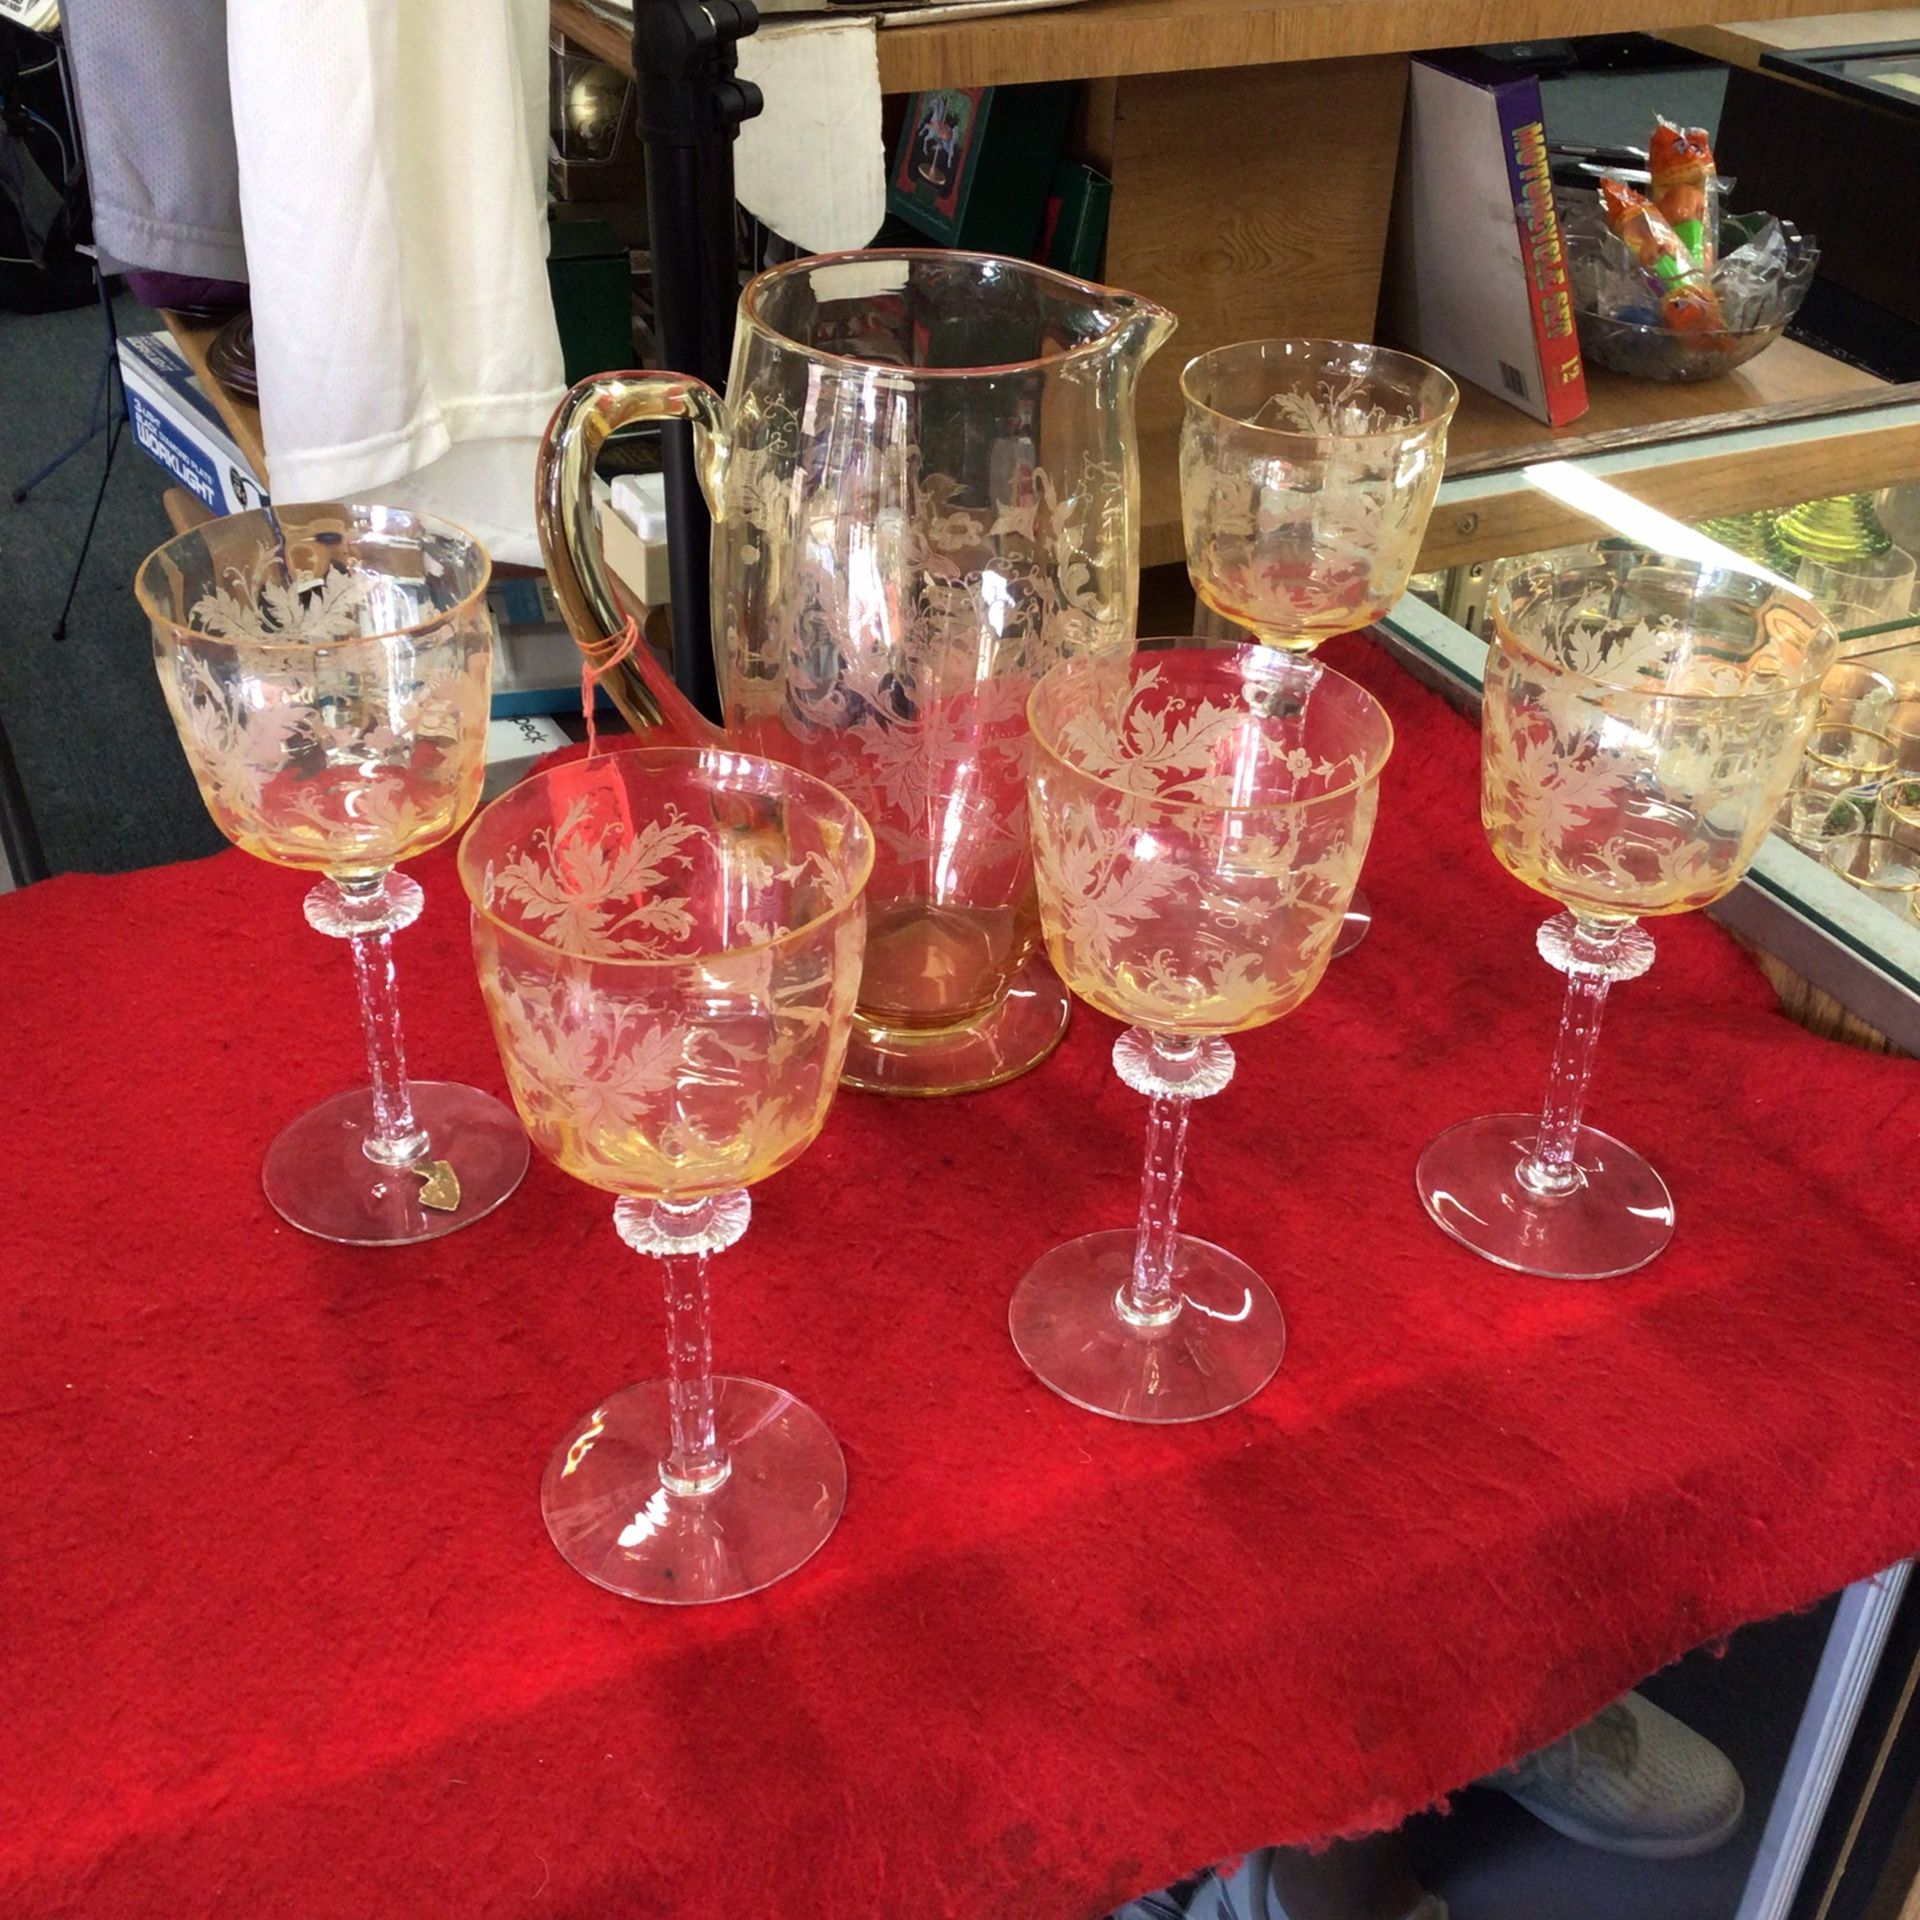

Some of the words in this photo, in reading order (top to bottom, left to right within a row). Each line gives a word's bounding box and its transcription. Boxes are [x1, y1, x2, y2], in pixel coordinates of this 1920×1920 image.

[1512, 121, 1566, 291] MOTORCYCLE
[1541, 290, 1573, 338] SET
[1561, 355, 1580, 384] 12
[136, 420, 215, 507] WORKLIGHT
[507, 716, 549, 744] peck
